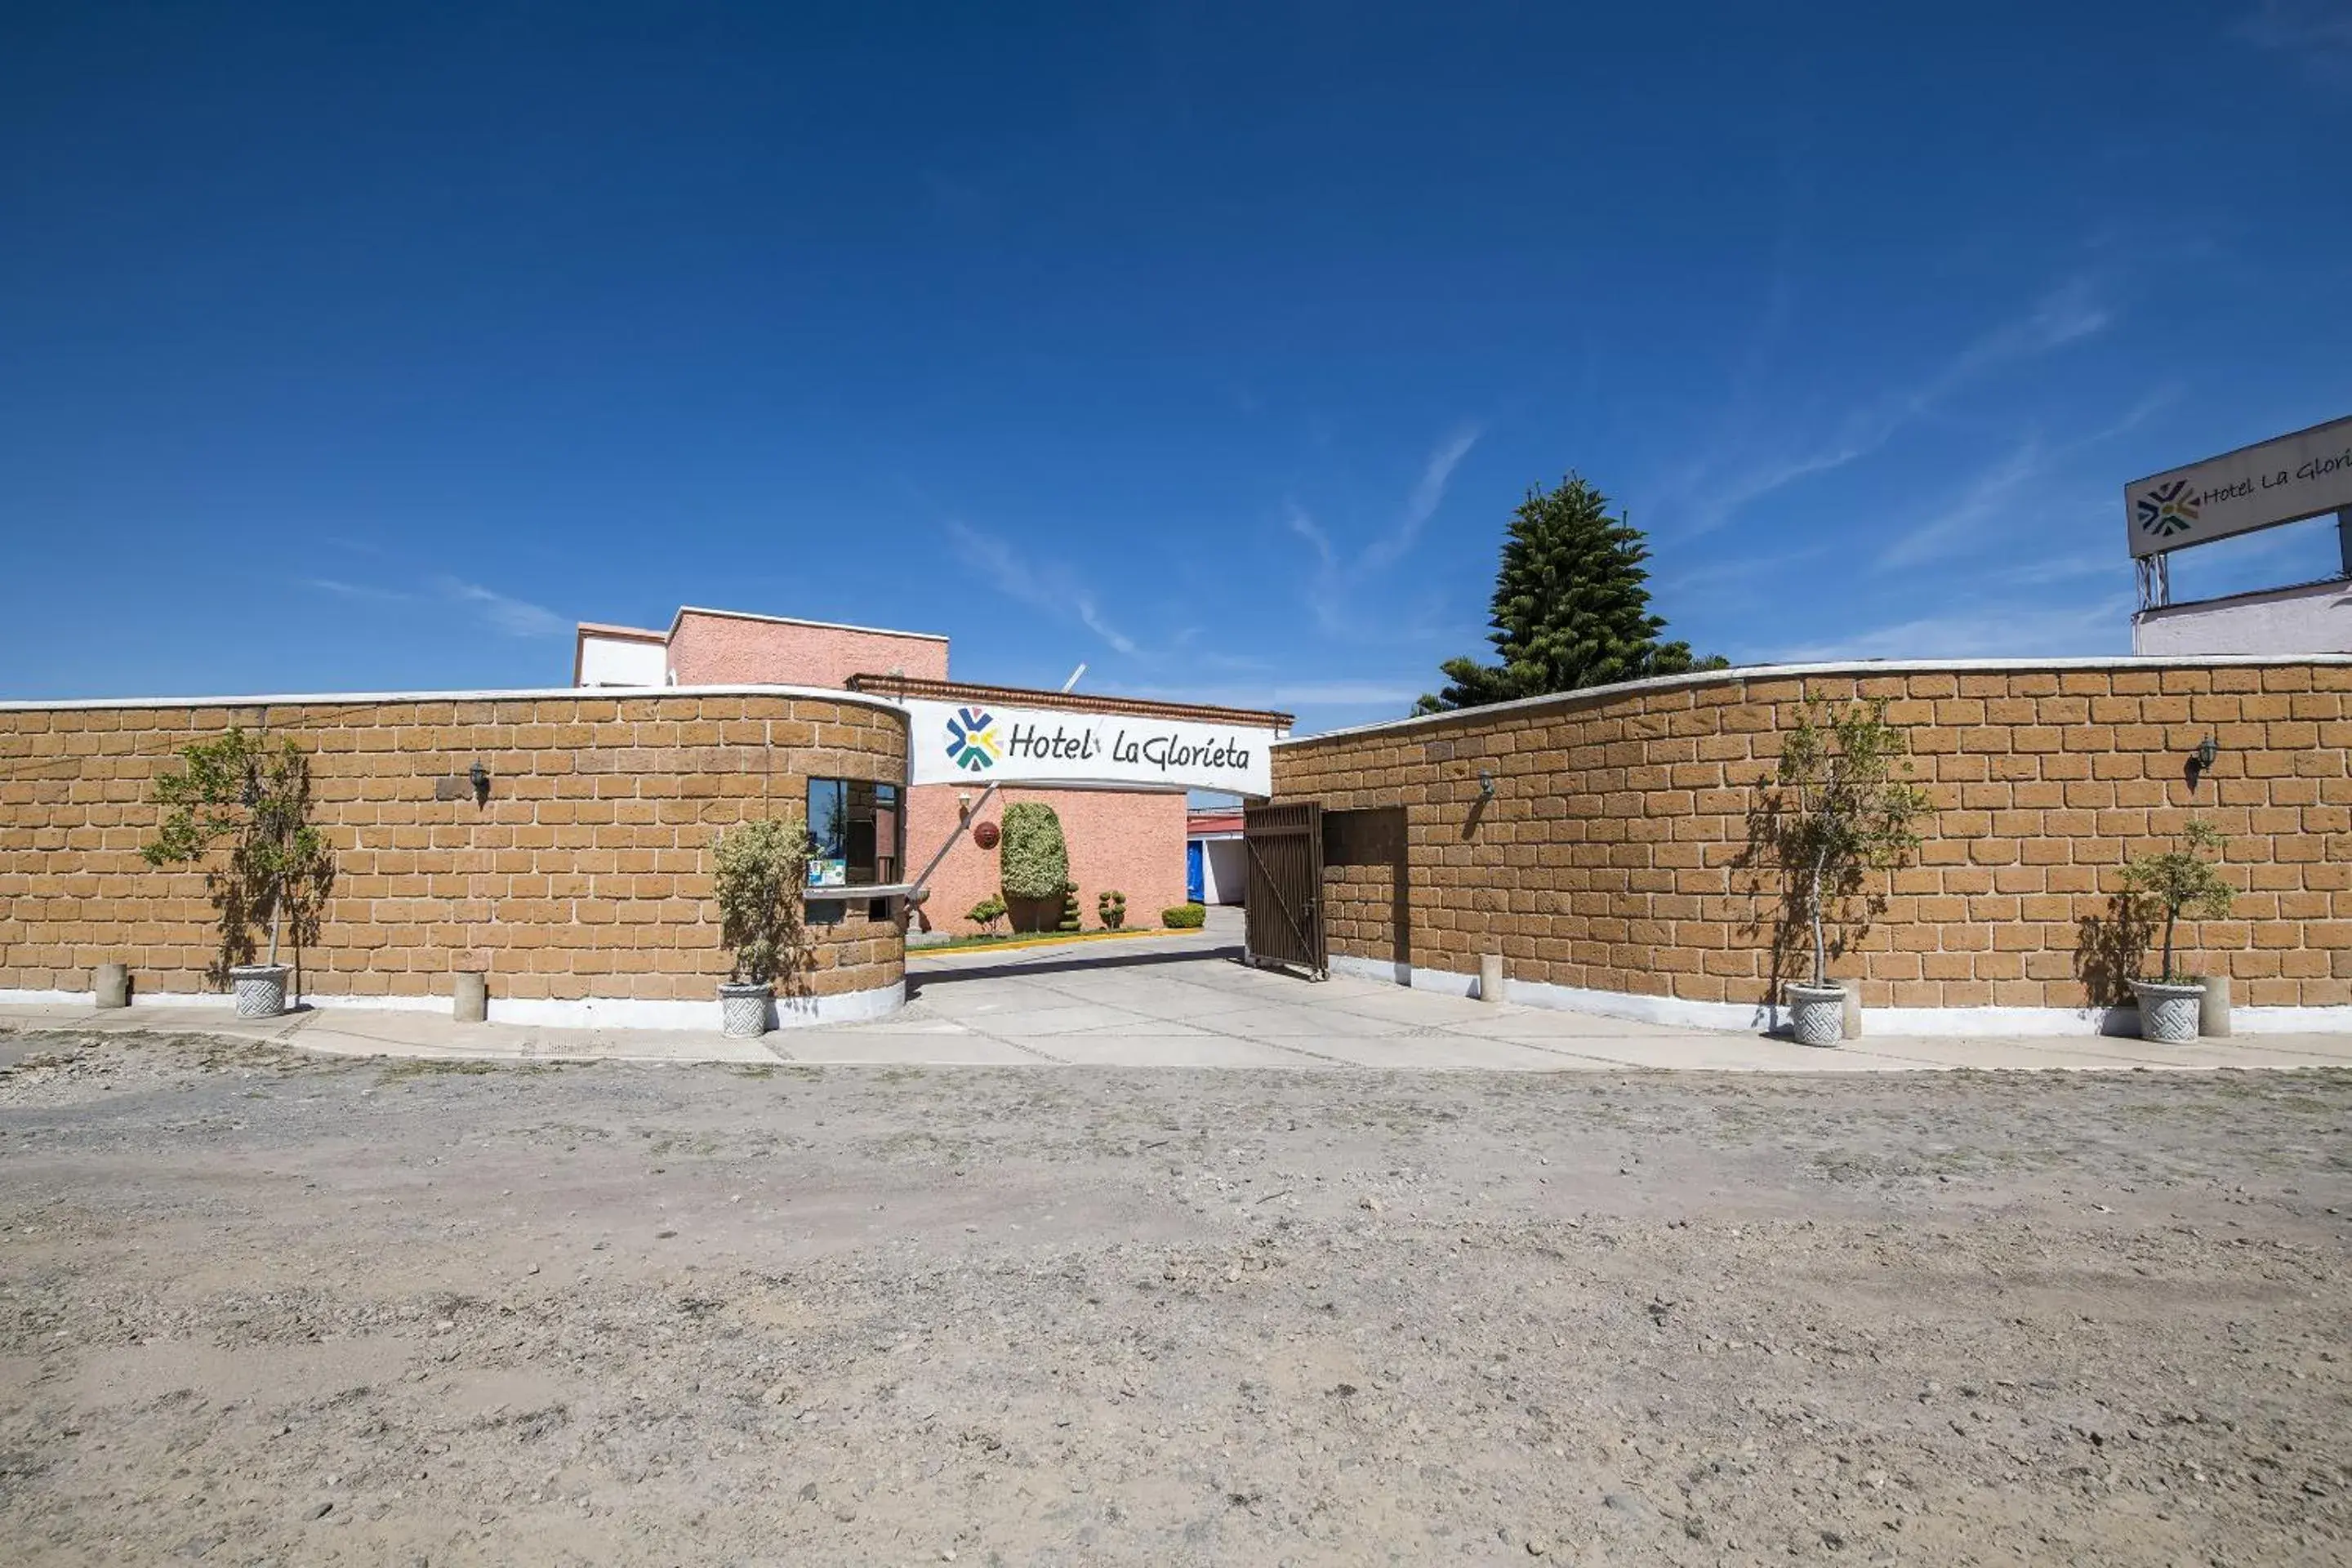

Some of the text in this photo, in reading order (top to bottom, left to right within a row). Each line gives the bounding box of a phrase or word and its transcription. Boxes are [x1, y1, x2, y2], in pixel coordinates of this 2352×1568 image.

[2204, 477, 2255, 505] Hotel
[2261, 470, 2288, 489] La
[1008, 723, 1094, 760] Hotel
[1112, 729, 1139, 764] La
